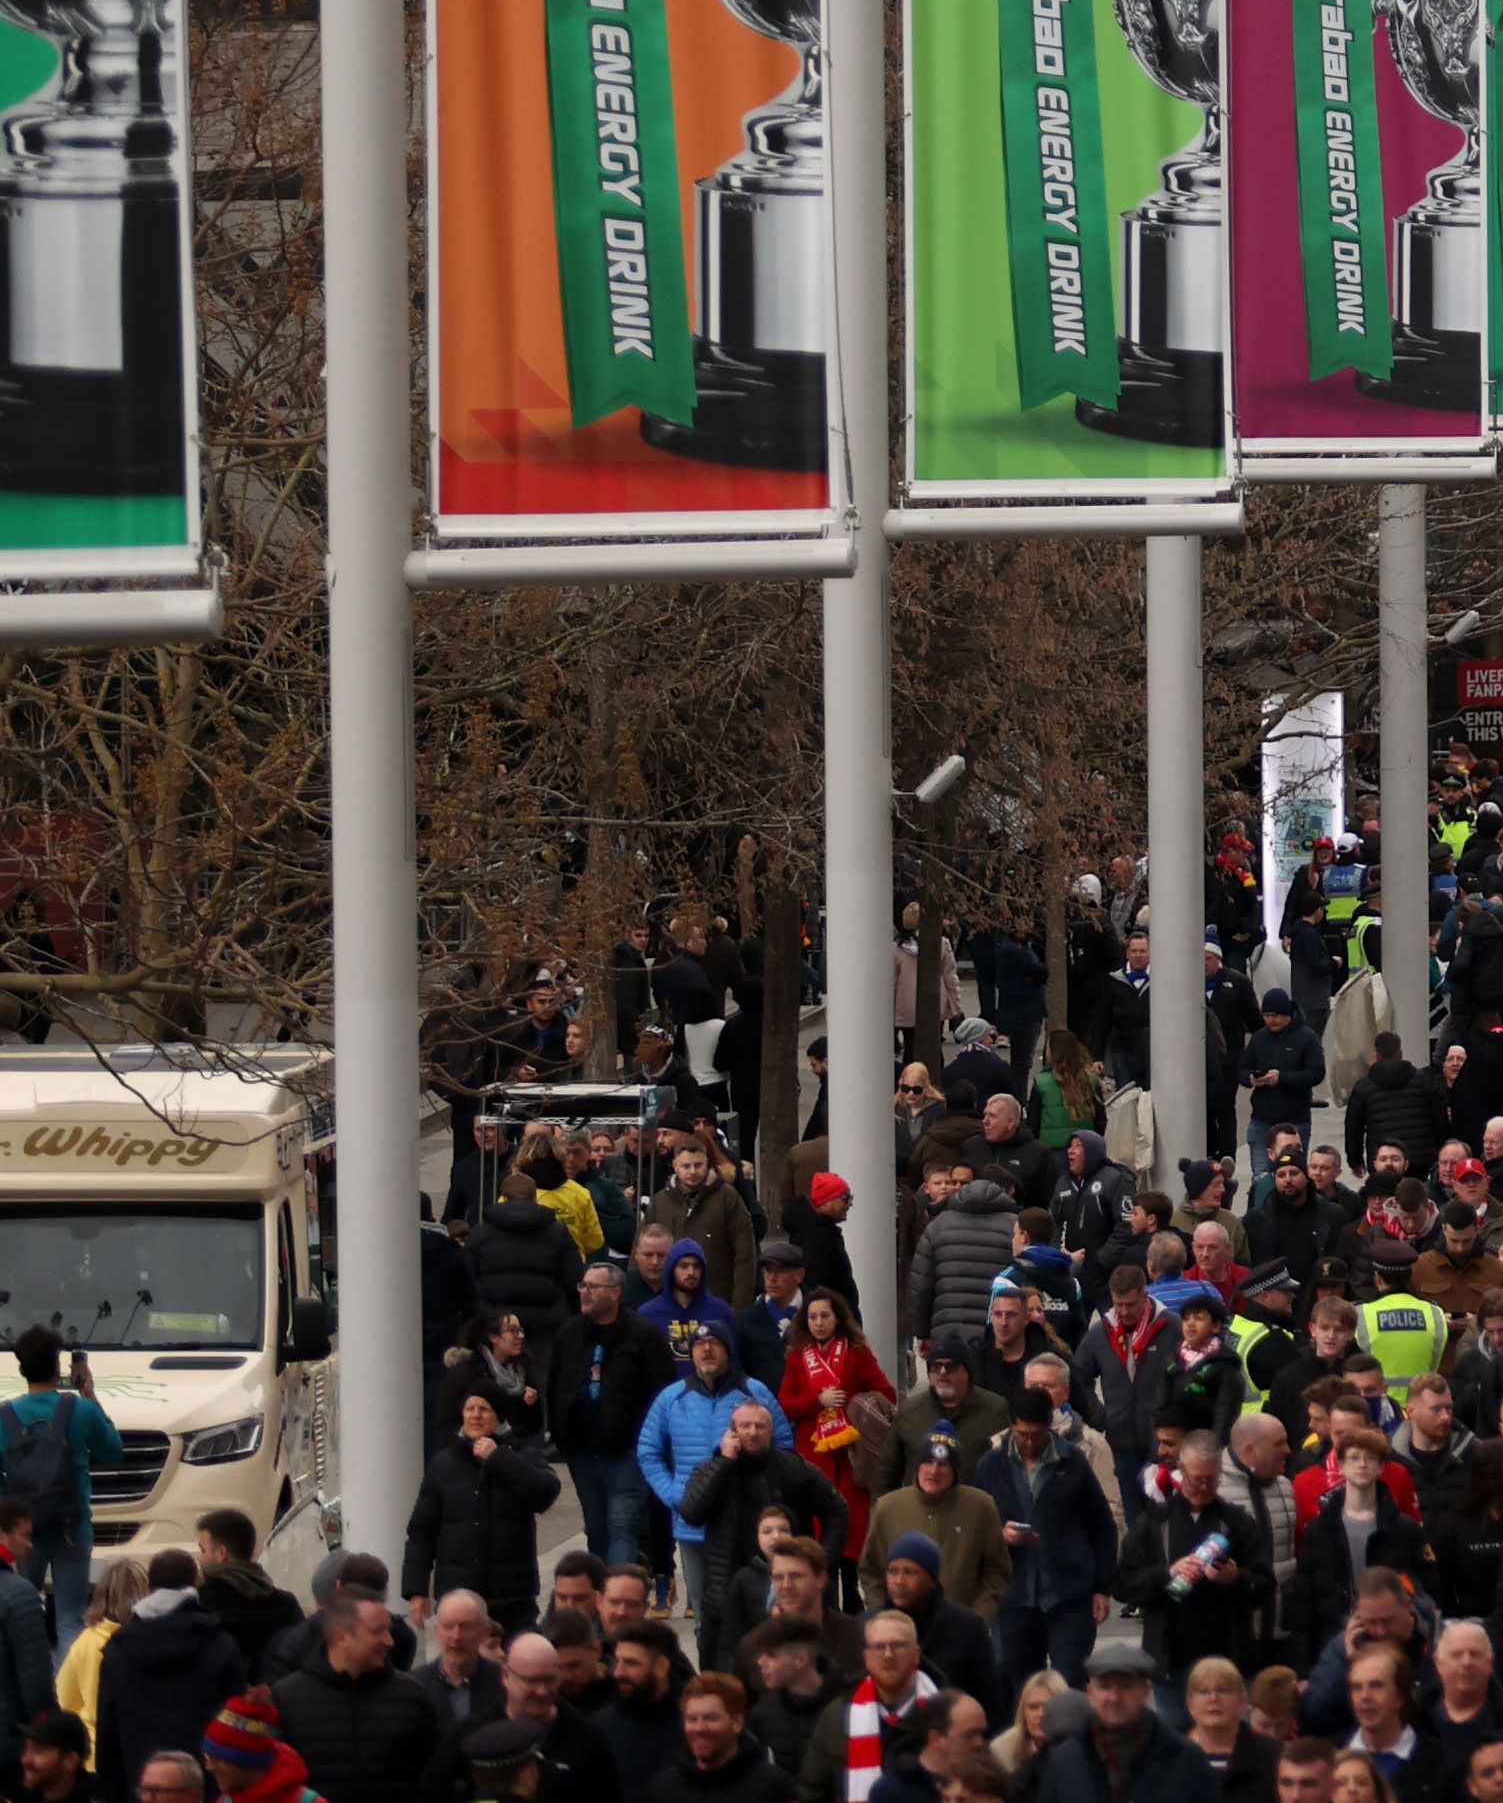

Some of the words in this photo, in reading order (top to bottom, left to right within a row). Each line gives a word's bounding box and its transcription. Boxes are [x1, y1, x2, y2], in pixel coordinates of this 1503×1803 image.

[588, 25, 645, 210] ENERGY
[1034, 86, 1079, 235] ENERGY
[1323, 109, 1362, 236] ENERGY
[602, 218, 653, 362] DRINK
[1044, 242, 1088, 357] DRINK
[1331, 240, 1368, 337] DRINK
[1466, 726, 1499, 742] THIS
[23, 1125, 222, 1167] Whippy
[1379, 1309, 1425, 1328] POLICE
